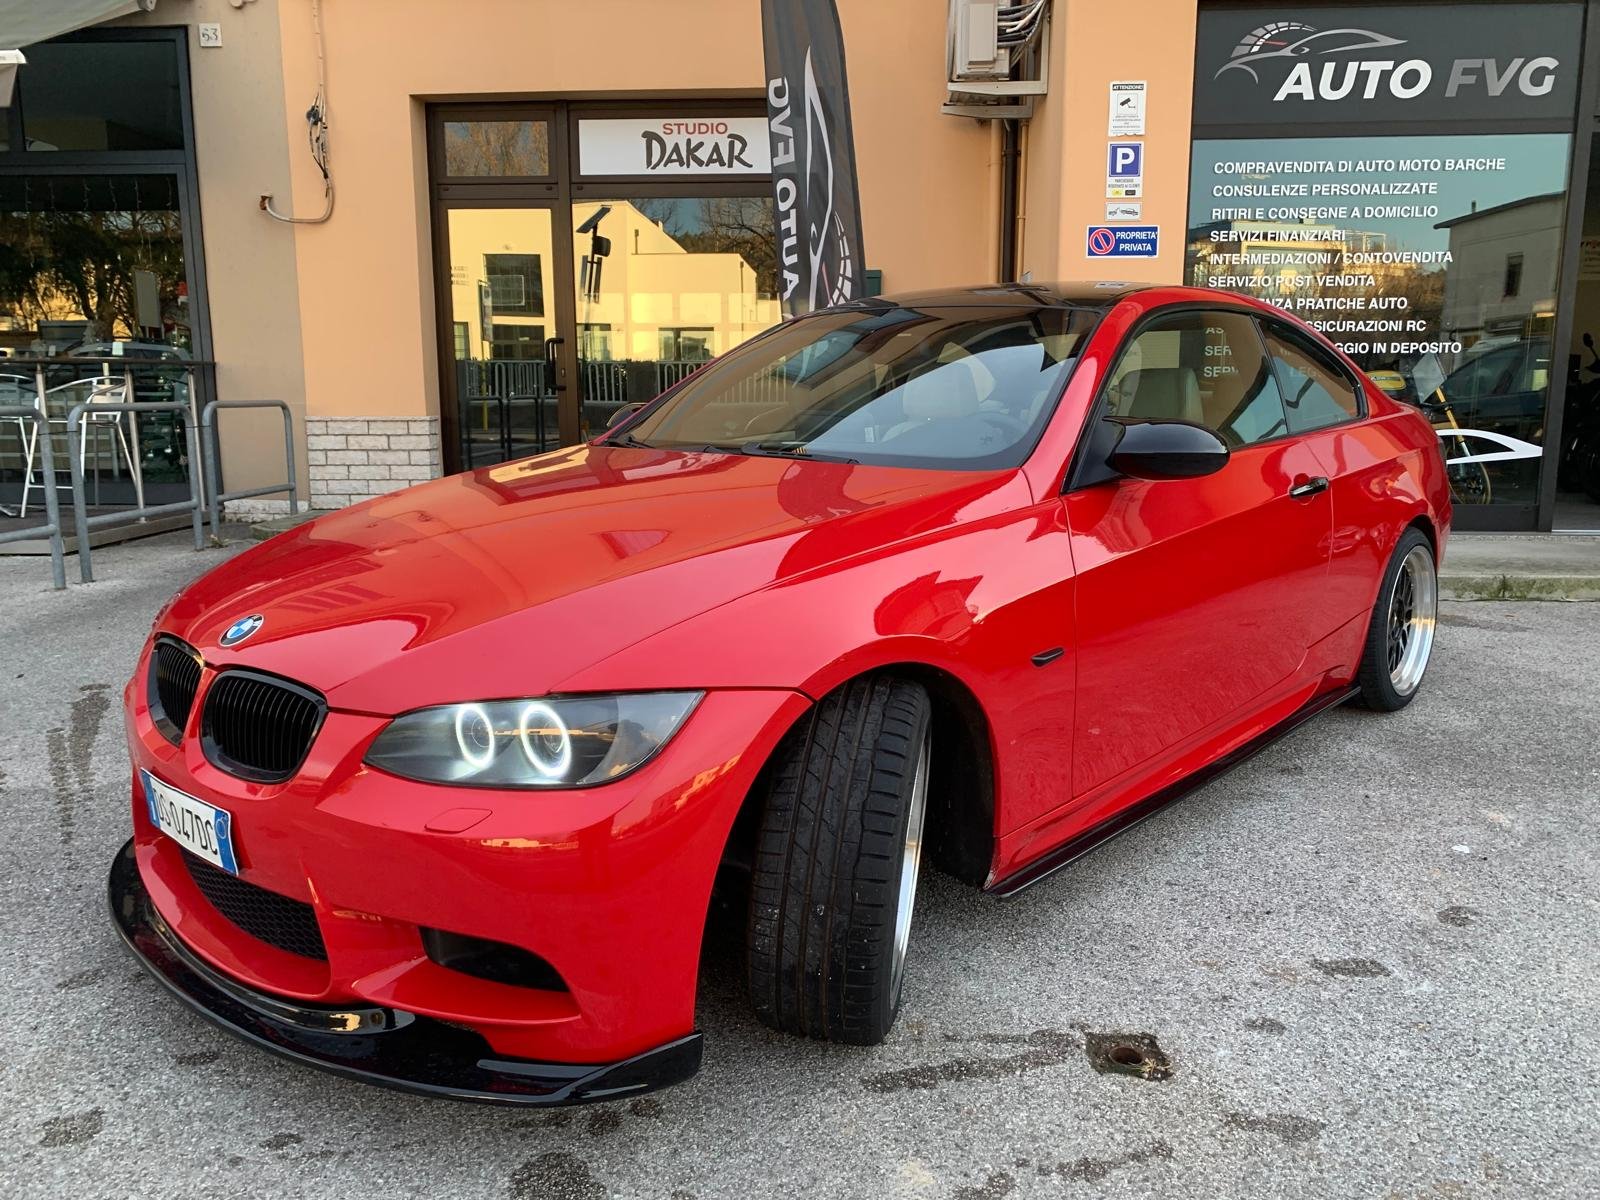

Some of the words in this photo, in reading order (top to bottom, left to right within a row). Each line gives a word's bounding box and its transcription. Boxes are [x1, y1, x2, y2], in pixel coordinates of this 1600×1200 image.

[1273, 59, 1432, 101] AUTO
[1445, 57, 1559, 97] FVG
[662, 122, 728, 135] STUDIO
[641, 130, 753, 170] DAKAR
[1116, 148, 1135, 173] P
[1214, 161, 1334, 174] COMPRAVENDITA
[1338, 161, 1352, 173] DI
[1355, 160, 1395, 172] AUTO
[1399, 159, 1441, 172] MOTO
[1445, 158, 1506, 171] BARCHE
[1213, 184, 1308, 197] CONSULENZE
[1312, 182, 1438, 196] PERSONALIZZATE
[1212, 207, 1252, 220] RITIRI
[1255, 207, 1265, 219] E
[1268, 206, 1347, 219] CONSEGNE
[1350, 206, 1361, 218] A
[1364, 205, 1439, 218] DOMICILIO
[1210, 230, 1263, 242] SERVIZI
[1268, 229, 1346, 241] FINANZIARI
[1119, 244, 1152, 252] PRIVATA
[1210, 253, 1331, 265] INTERMEDIAZIONI
[1333, 252, 1341, 264] /
[1343, 251, 1453, 264] CONTOVENDITA
[1208, 275, 1271, 287] SERVIZIO
[1275, 275, 1313, 287] POST
[1317, 275, 1375, 287] VENDITA
[1296, 297, 1365, 310] PRATICHE
[1368, 297, 1408, 309] AUTO
[1406, 320, 1427, 332] RC
[1373, 342, 1387, 354] IN
[1390, 342, 1462, 354] DEPOSITO
